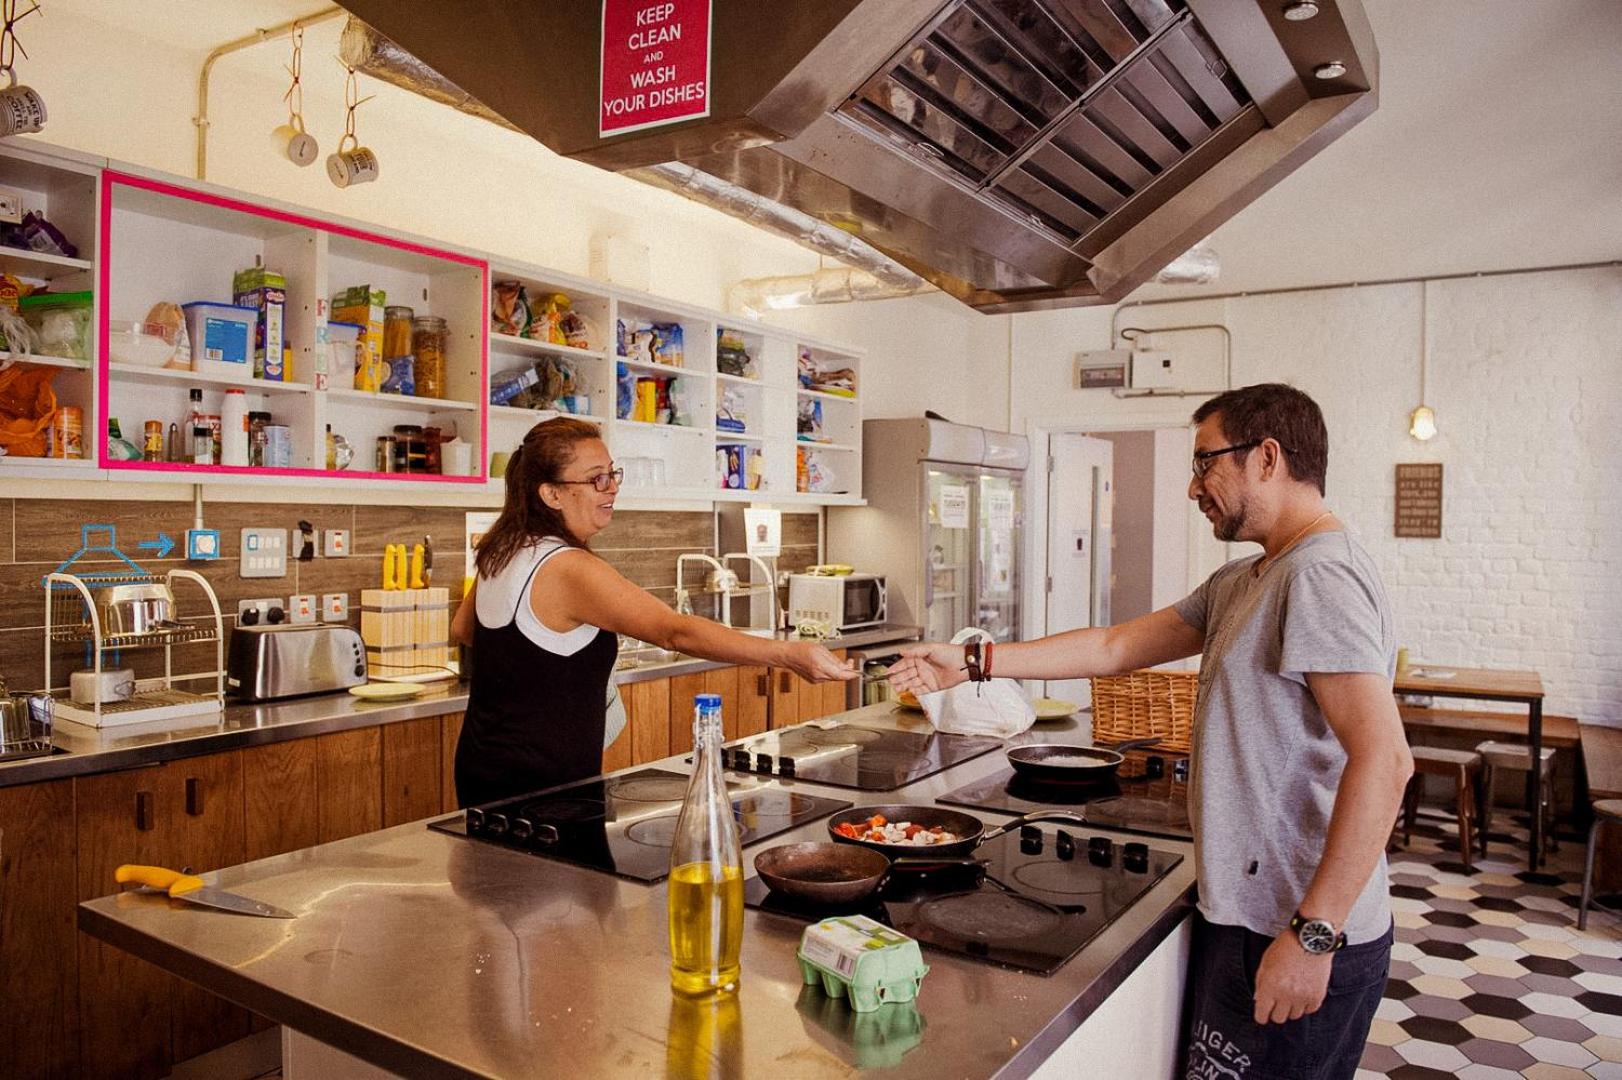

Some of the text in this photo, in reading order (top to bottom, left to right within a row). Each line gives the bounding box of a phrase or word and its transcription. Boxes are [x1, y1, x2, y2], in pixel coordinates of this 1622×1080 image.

[636, 3, 675, 27] KEEP
[628, 23, 682, 51] CLEAN
[643, 51, 664, 64] AND
[630, 65, 676, 89] WASH
[604, 82, 705, 117] YOUR DISHES
